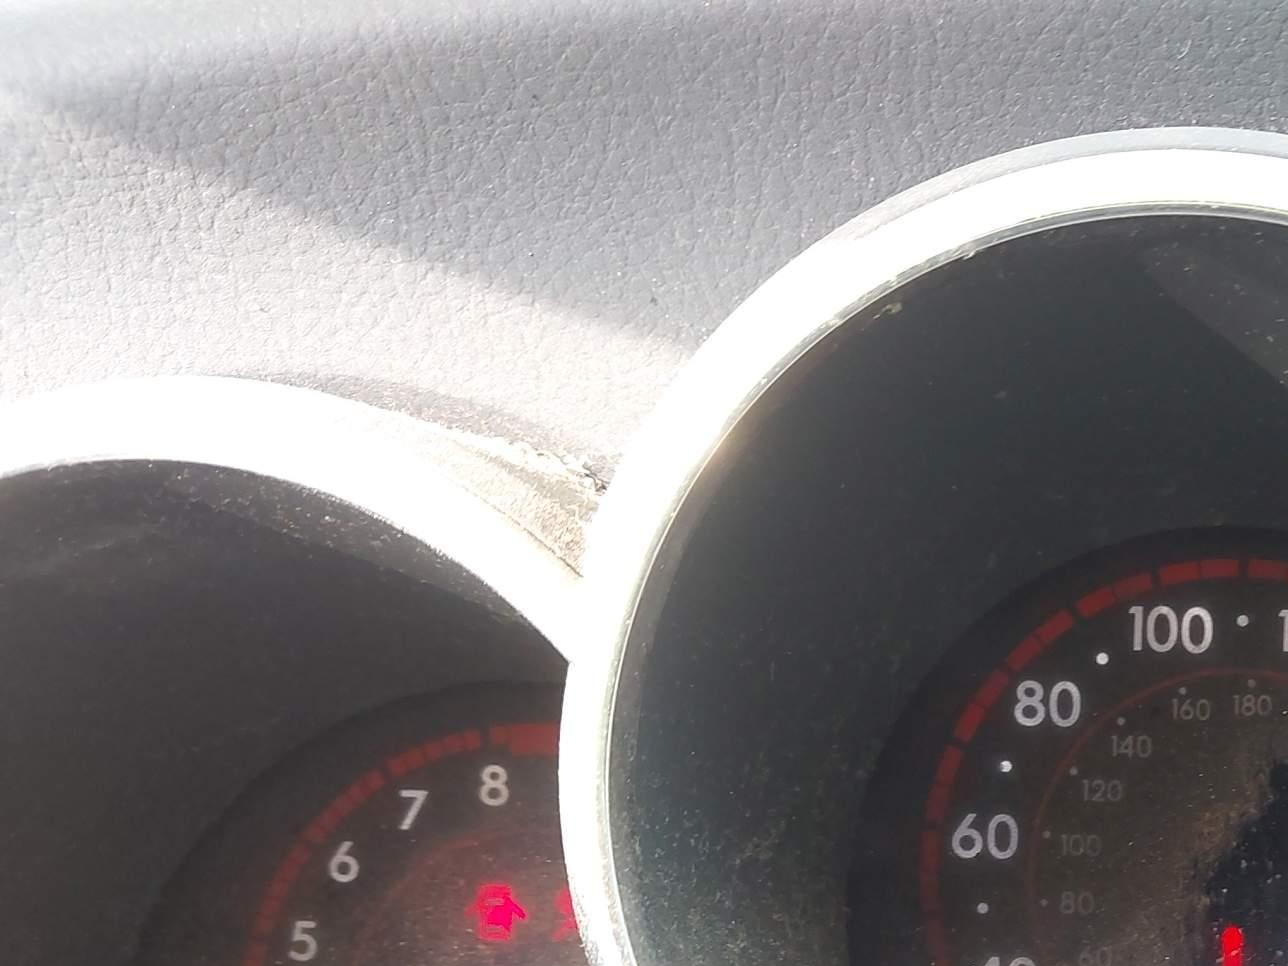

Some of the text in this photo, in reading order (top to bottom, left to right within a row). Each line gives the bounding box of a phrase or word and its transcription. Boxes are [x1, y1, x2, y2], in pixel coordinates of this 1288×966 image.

[1128, 606, 1213, 654] 100
[1014, 680, 1081, 727] 80
[1172, 699, 1210, 720] 160
[1233, 695, 1272, 716] 180
[1111, 735, 1151, 758] 140
[479, 764, 509, 806] 8
[1082, 779, 1122, 802] 120
[399, 789, 429, 830] 7
[951, 813, 1019, 859] 60
[1061, 834, 1100, 856] 100
[328, 841, 360, 883] 6
[1060, 891, 1095, 915] 80
[289, 920, 318, 962] 5
